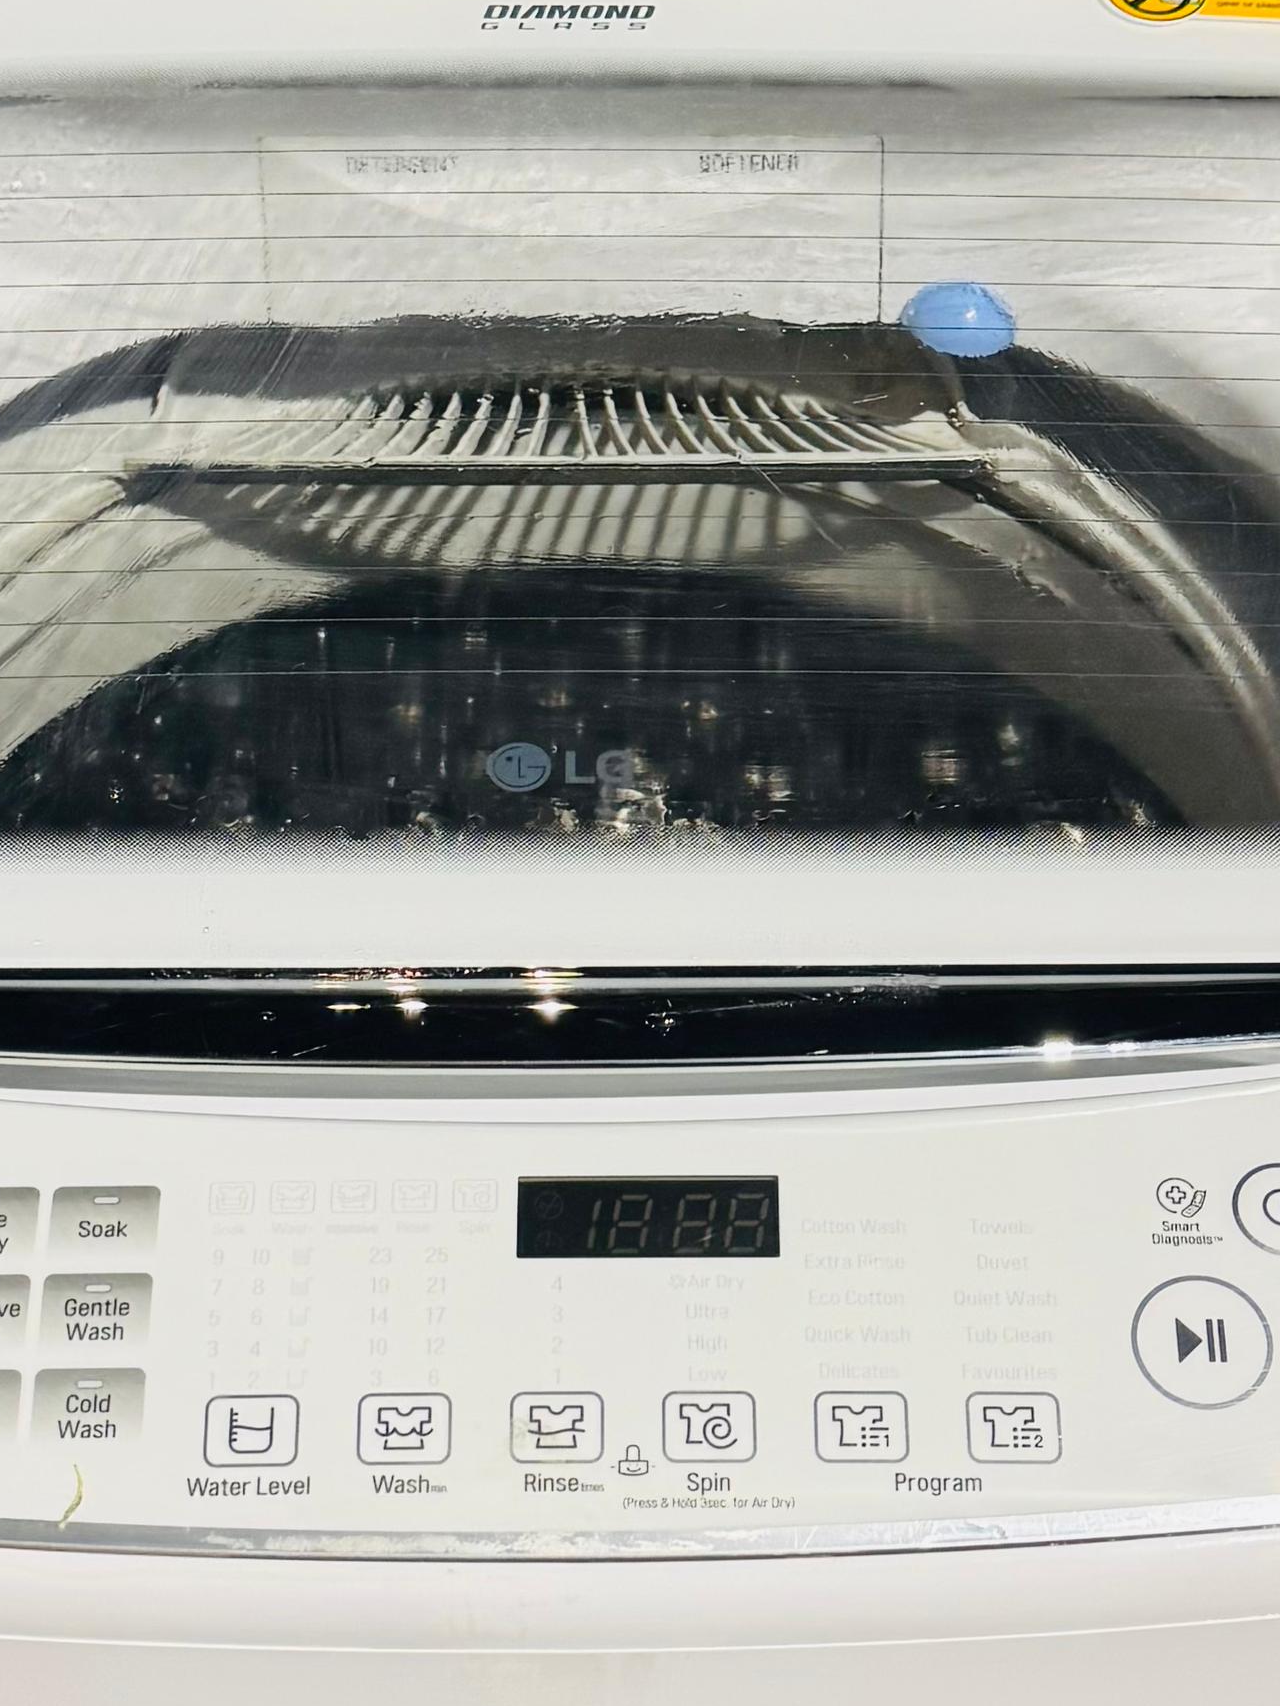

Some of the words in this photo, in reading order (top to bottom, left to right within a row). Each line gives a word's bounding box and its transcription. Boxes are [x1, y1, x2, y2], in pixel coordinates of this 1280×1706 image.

[483, 4, 656, 19] DIAMOND
[480, 21, 647, 31] GLASS
[565, 749, 634, 785] LG
[78, 1221, 128, 1238] Soak
[1162, 1220, 1201, 1232] Smart
[64, 1298, 130, 1317] Gentle
[685, 1304, 729, 1319] Ultra
[66, 1323, 124, 1341] Wash
[688, 1334, 728, 1354] High
[688, 1365, 728, 1382] Low
[65, 1394, 111, 1413] Cold
[58, 1419, 116, 1438] Wash
[187, 1477, 251, 1497] Water
[257, 1476, 311, 1495] Level
[372, 1474, 430, 1494] Wash
[524, 1473, 579, 1493] Rinse
[687, 1472, 731, 1496] Spin
[895, 1473, 983, 1496] Program
[672, 1497, 697, 1509] Hold
[752, 1497, 768, 1509] Air
